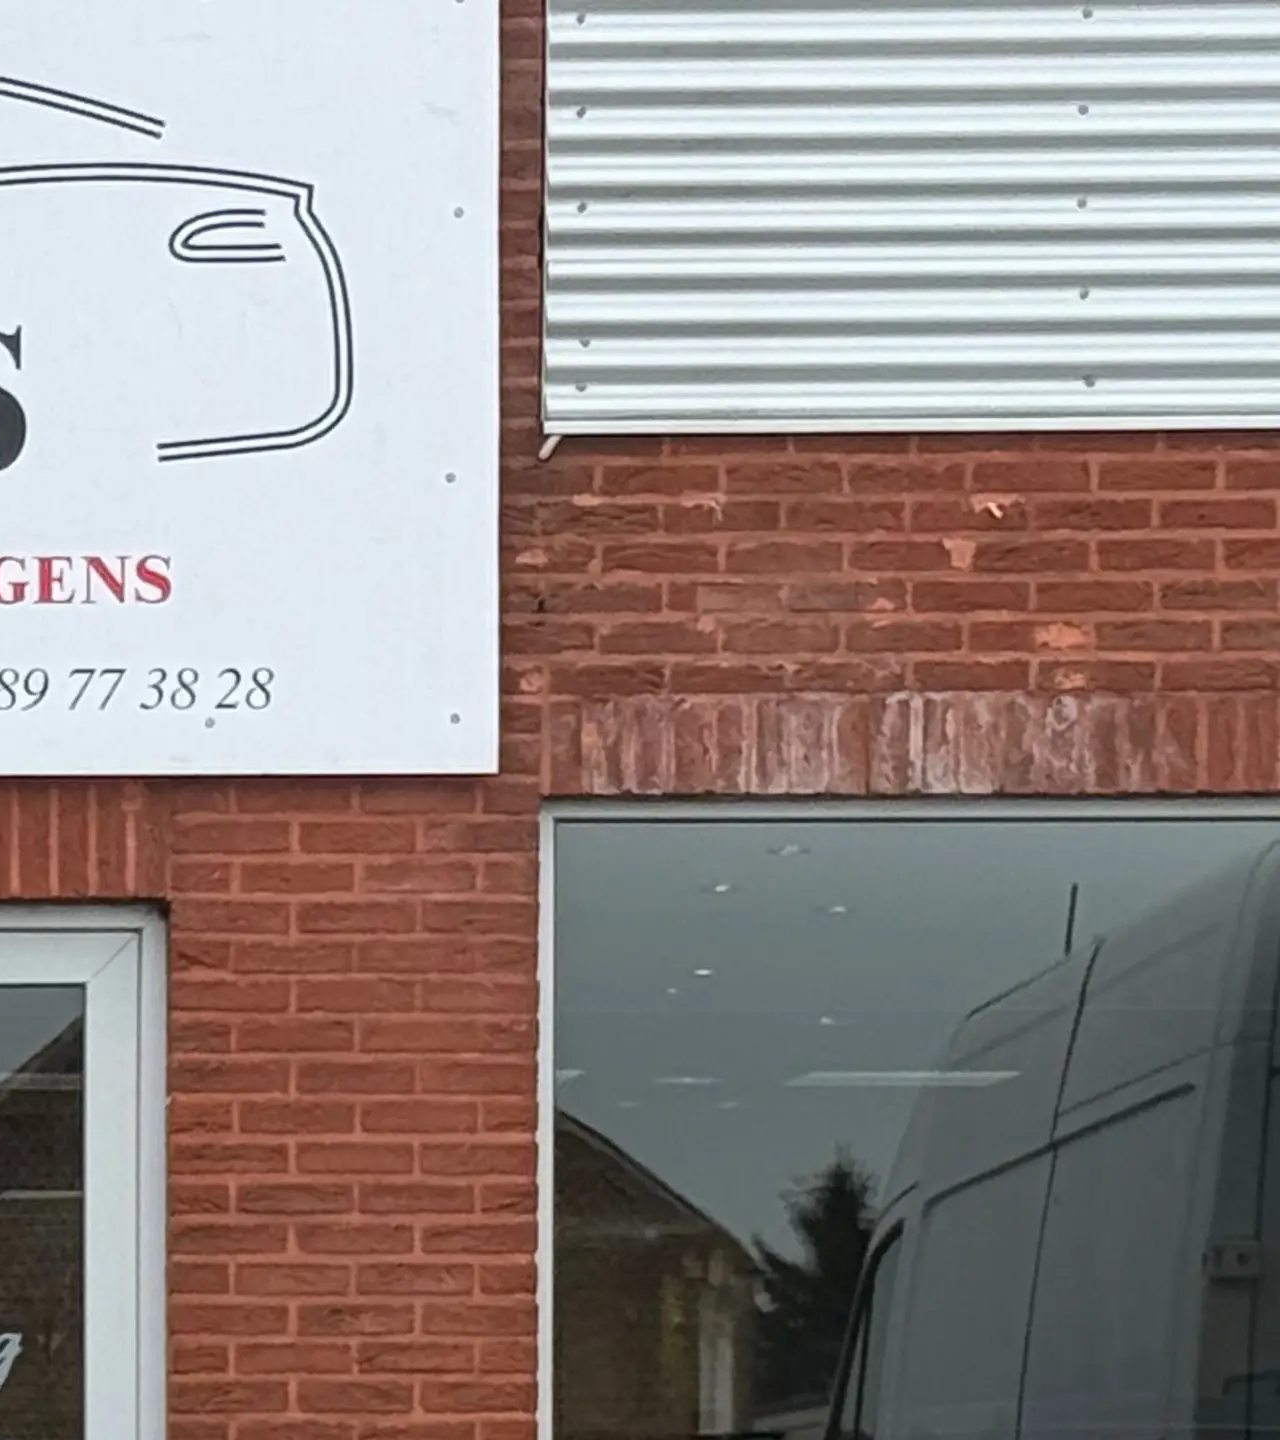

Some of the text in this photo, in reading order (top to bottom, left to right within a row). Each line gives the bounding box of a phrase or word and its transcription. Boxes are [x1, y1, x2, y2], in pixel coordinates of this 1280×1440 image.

[70, 668, 127, 710] 77
[141, 668, 197, 710] 38
[215, 668, 271, 710] 28
